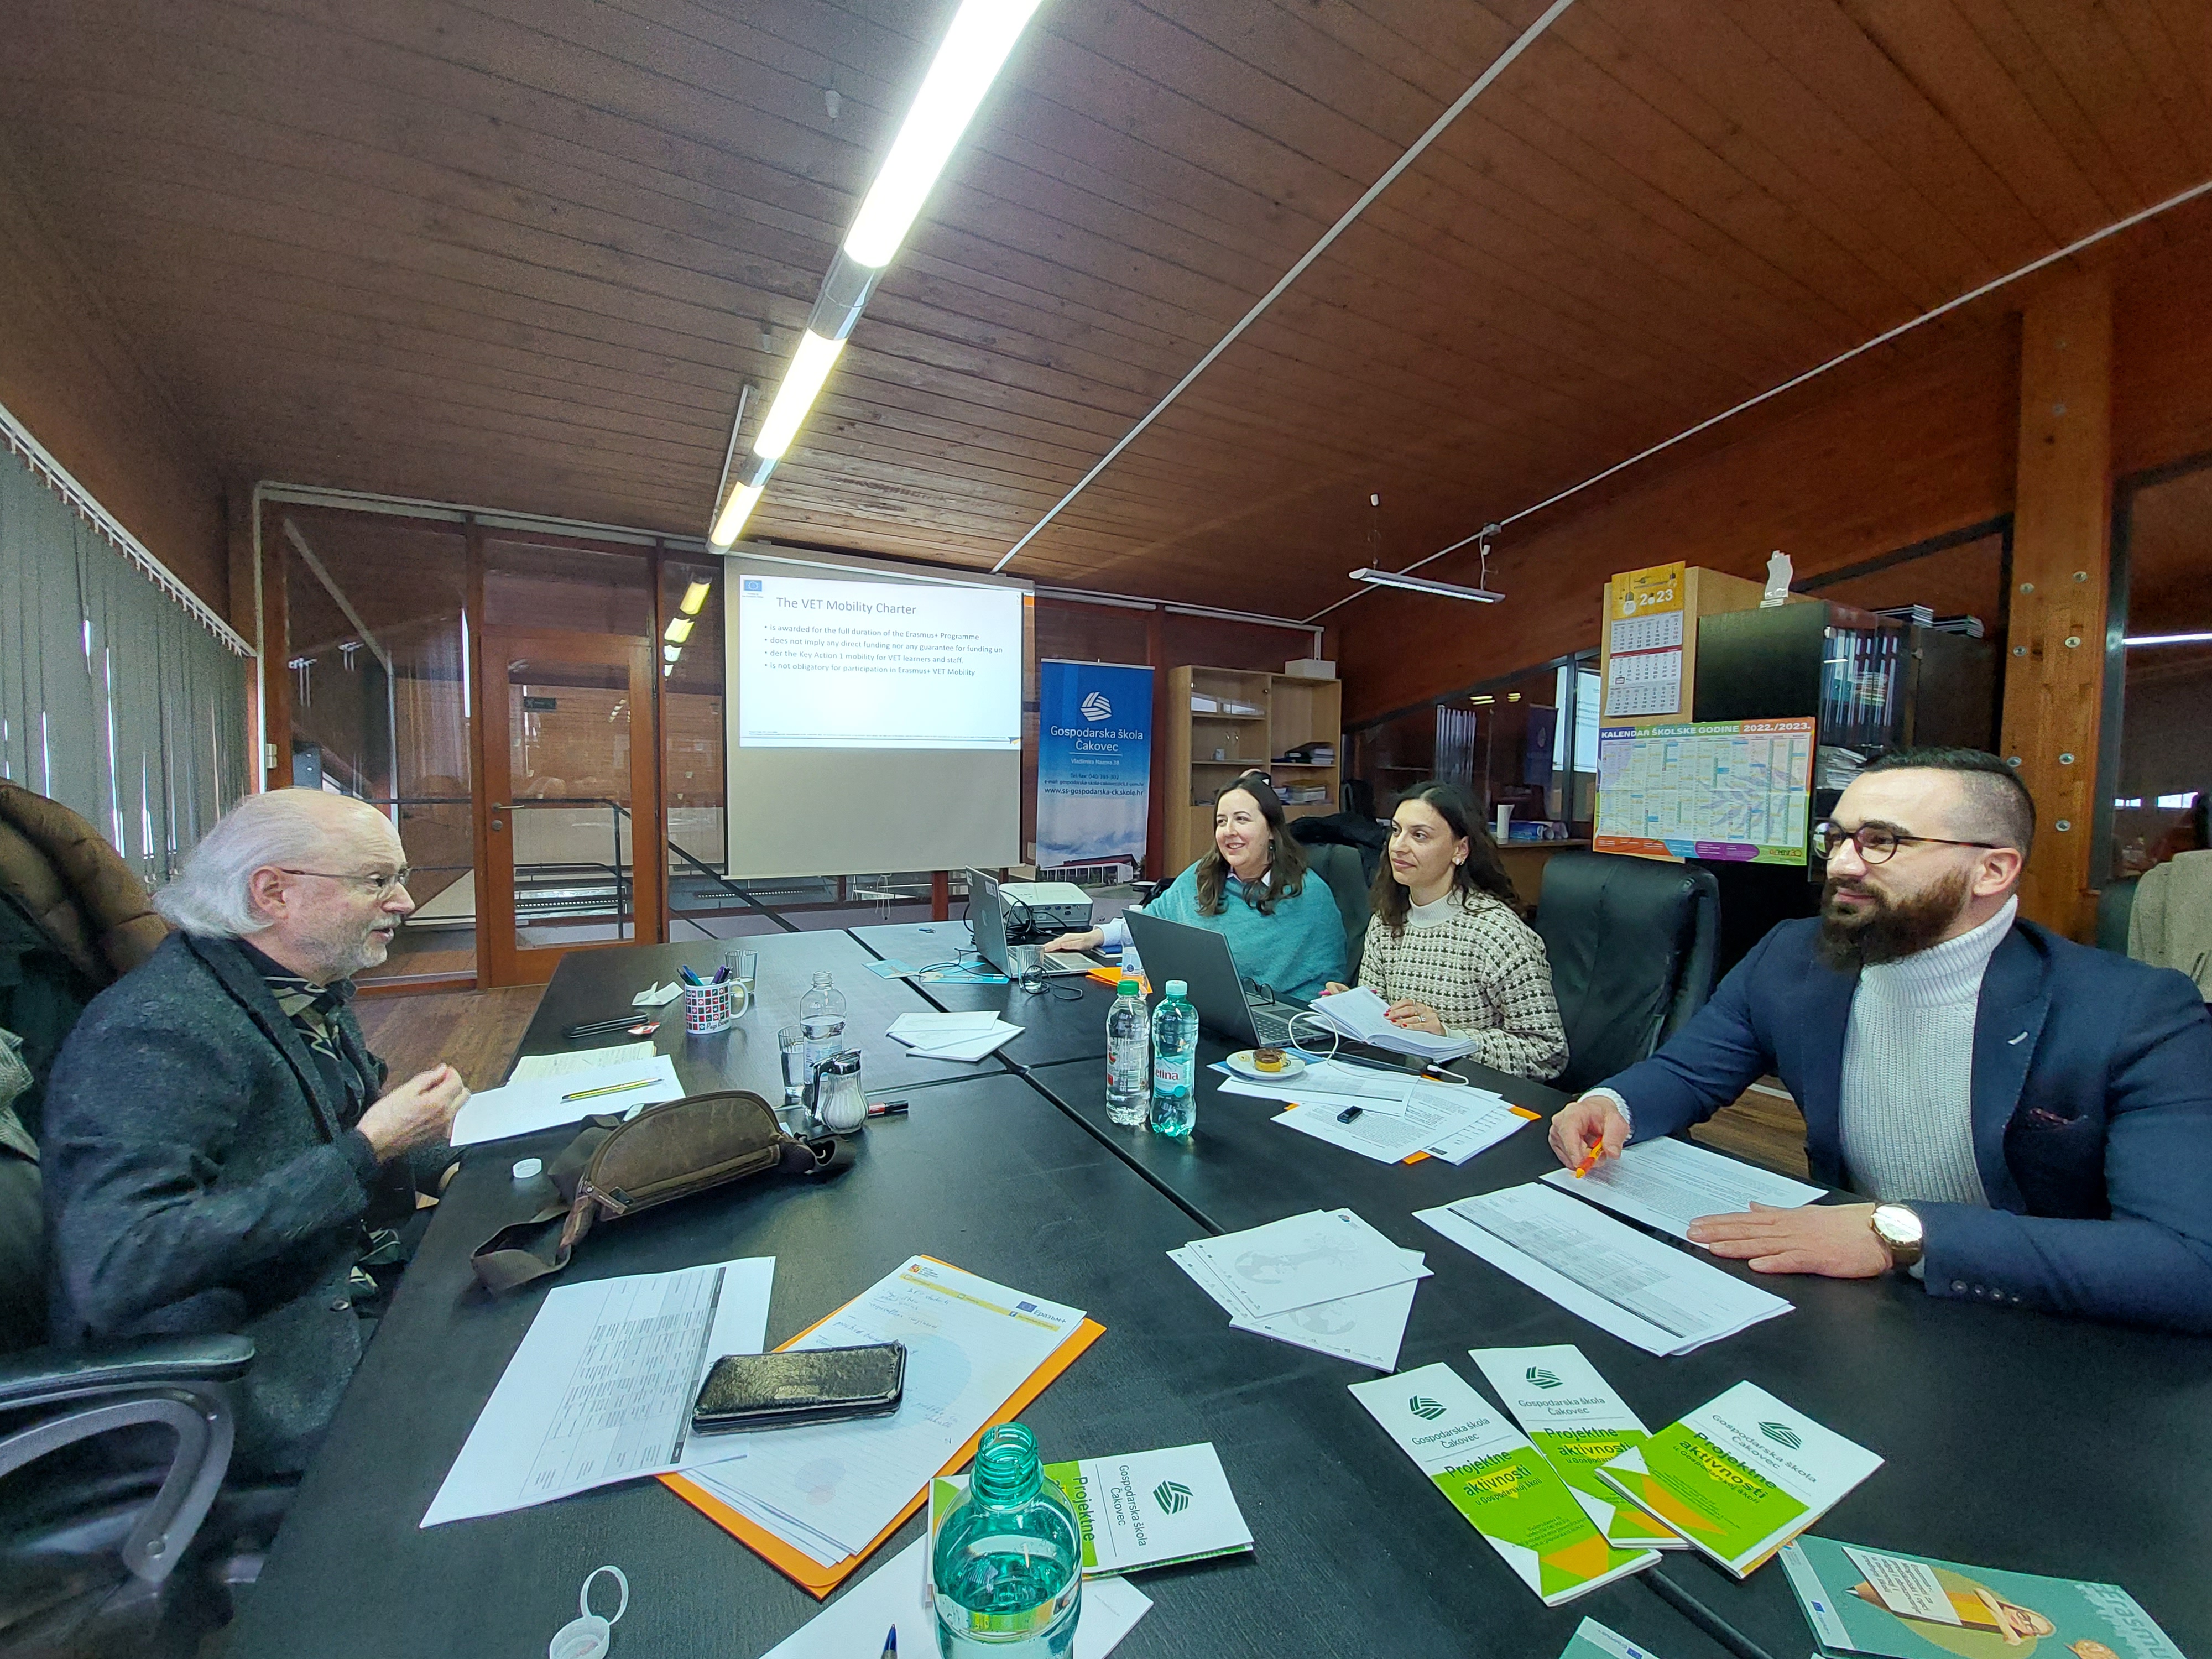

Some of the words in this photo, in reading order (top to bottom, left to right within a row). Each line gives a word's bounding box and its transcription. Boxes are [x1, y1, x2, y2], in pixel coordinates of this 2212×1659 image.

[776, 597, 797, 608] The
[801, 599, 823, 609] VET
[827, 601, 873, 614] Mobility
[876, 603, 916, 614] Charter
[1640, 588, 1673, 606] 2023
[940, 632, 979, 640] Programme
[863, 641, 890, 649] funding
[967, 645, 993, 654] funding
[792, 663, 829, 671] obligatory
[843, 665, 888, 673] participation
[1051, 726, 1116, 739] Gospodarska
[1118, 729, 1143, 740] škola
[1601, 729, 1650, 738] KALENDAR
[1651, 727, 1697, 736] ŠKOLSKE
[1698, 725, 1740, 734] GODINE
[1743, 722, 1811, 732] 2022./2023.
[1076, 738, 1119, 752] Čakovec
[1044, 787, 1144, 796] www.ss-gospodarska-ck.skole.hr
[1155, 1068, 1180, 1081] etina
[1518, 1398, 1579, 1408] Gospodarska
[1580, 1396, 1606, 1405] škola
[1548, 1406, 1590, 1416] Čakovec
[1411, 1423, 1468, 1446] Gospodarska
[1467, 1417, 1490, 1430] škola
[1441, 1431, 1480, 1449] Čakovec
[1543, 1427, 1619, 1442] Projektne
[1557, 1441, 1632, 1456] aktivnosti
[1712, 1415, 1784, 1463] Gospodarska
[1785, 1460, 1817, 1483] škola
[1731, 1434, 1781, 1470] Čakovec
[1443, 1451, 1513, 1479] Projektne
[1693, 1431, 1777, 1489] Projektne
[1679, 1440, 1769, 1499] aktivnosti
[1680, 1449, 1738, 1491] Gospodarskoj
[1737, 1488, 1761, 1504] školi
[1463, 1463, 1533, 1497] aktivnosti
[1480, 1483, 1527, 1505] Gospodarskoj
[1525, 1477, 1543, 1491] školi
[1073, 1476, 1095, 1542] Projektne
[1110, 1486, 1126, 1526] Čakovec
[1119, 1464, 1140, 1521] Gospodarska
[1133, 1522, 1148, 1547] škola
